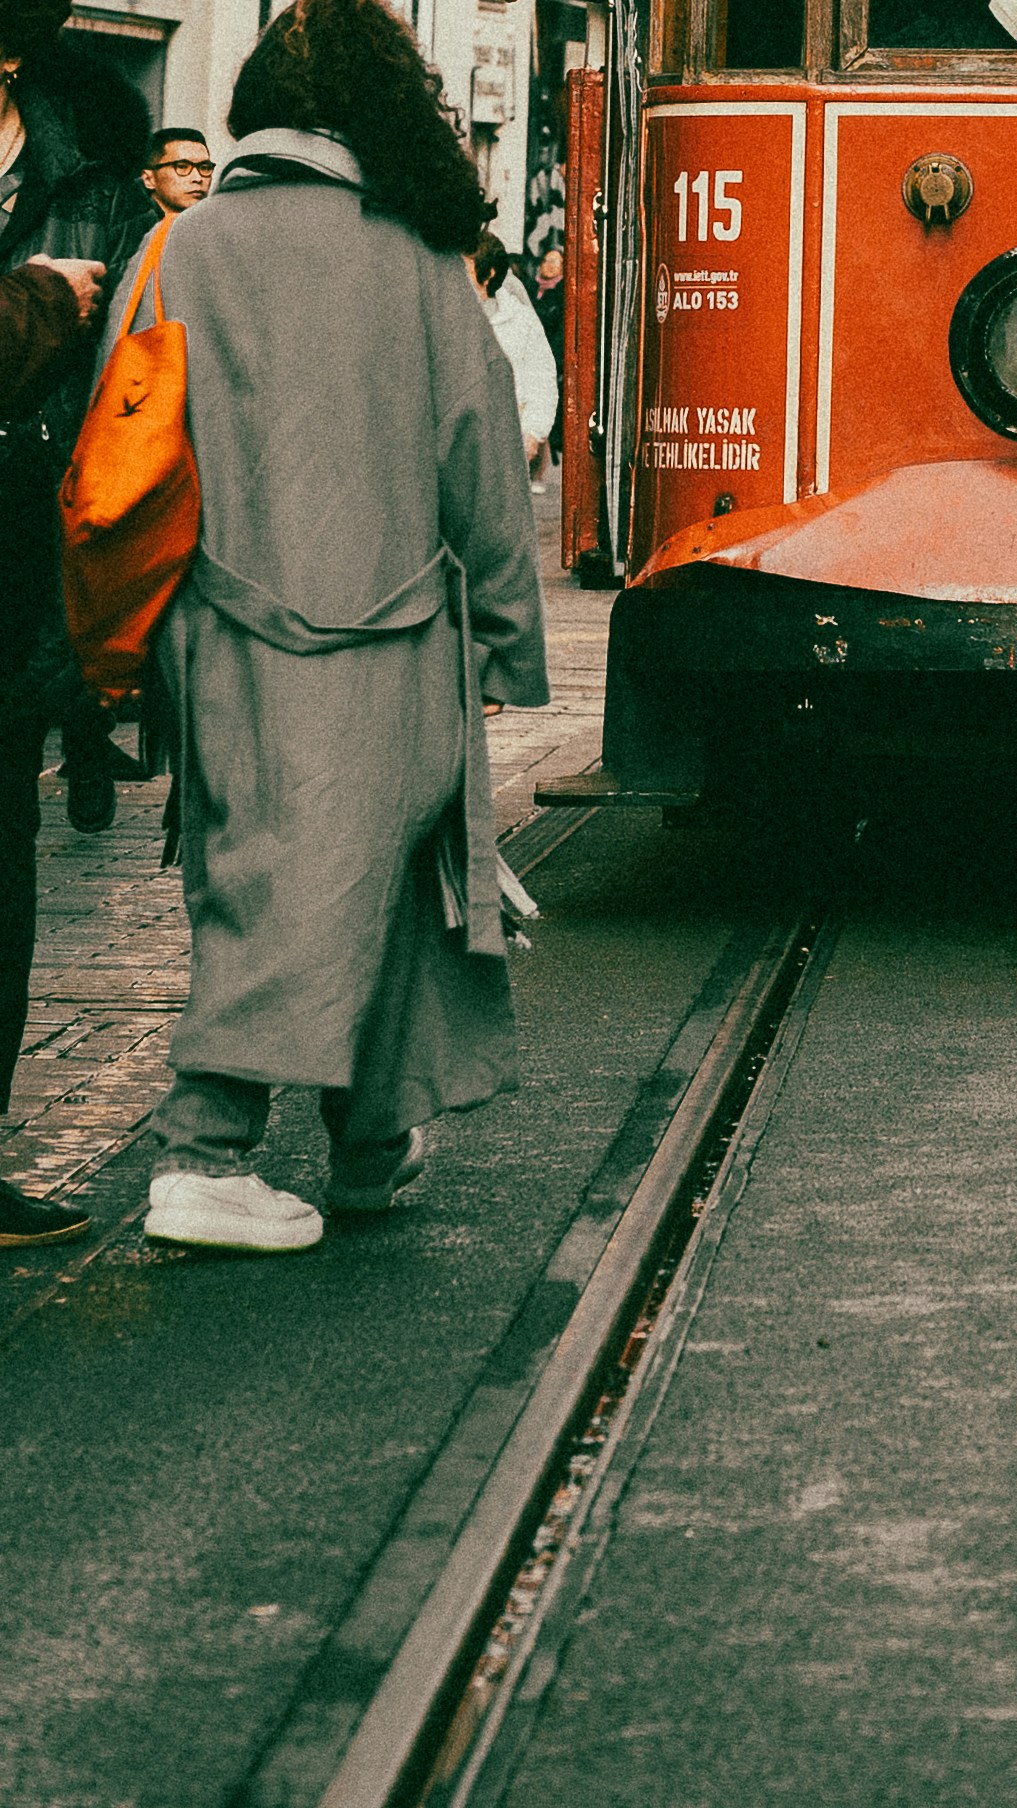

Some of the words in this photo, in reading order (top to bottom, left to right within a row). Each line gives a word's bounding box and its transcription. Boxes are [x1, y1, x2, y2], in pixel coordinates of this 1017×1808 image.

[674, 170, 743, 242] 115
[673, 291, 702, 310] ALO
[706, 291, 739, 310] 153
[696, 407, 757, 436] YASAK
[653, 438, 761, 471] TEHLİKELİDİR
